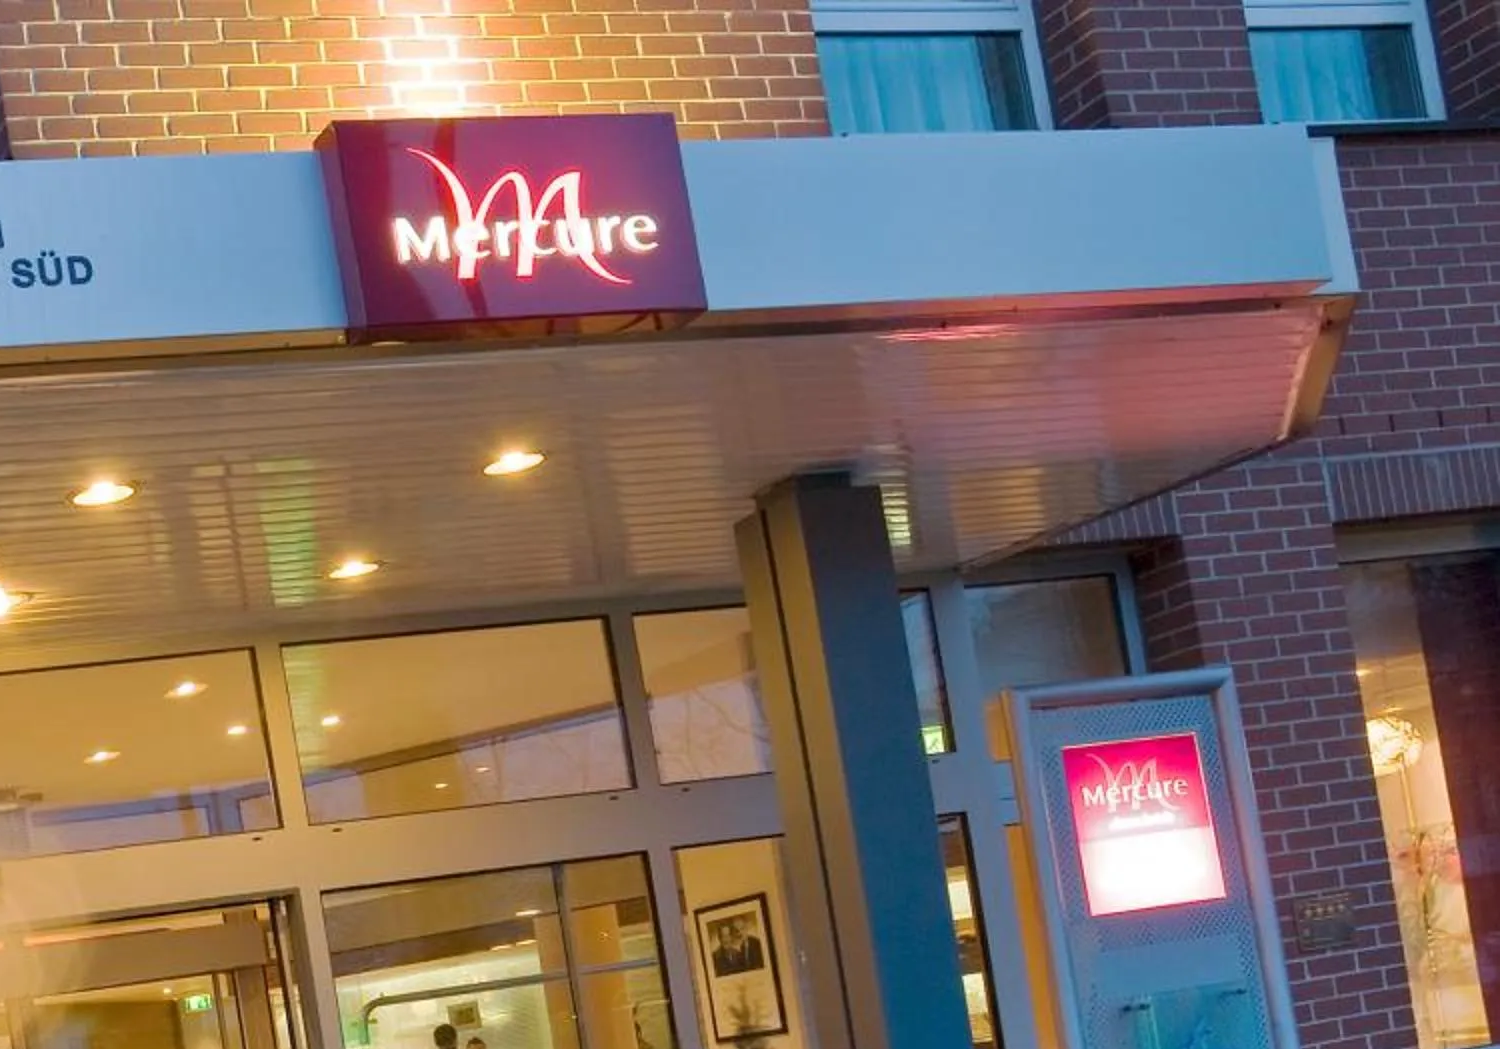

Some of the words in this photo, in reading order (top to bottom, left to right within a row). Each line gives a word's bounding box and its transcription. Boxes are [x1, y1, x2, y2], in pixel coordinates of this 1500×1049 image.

[395, 213, 661, 264] Mercure
[10, 252, 93, 289] SÜD
[1081, 778, 1189, 808] Mercure
